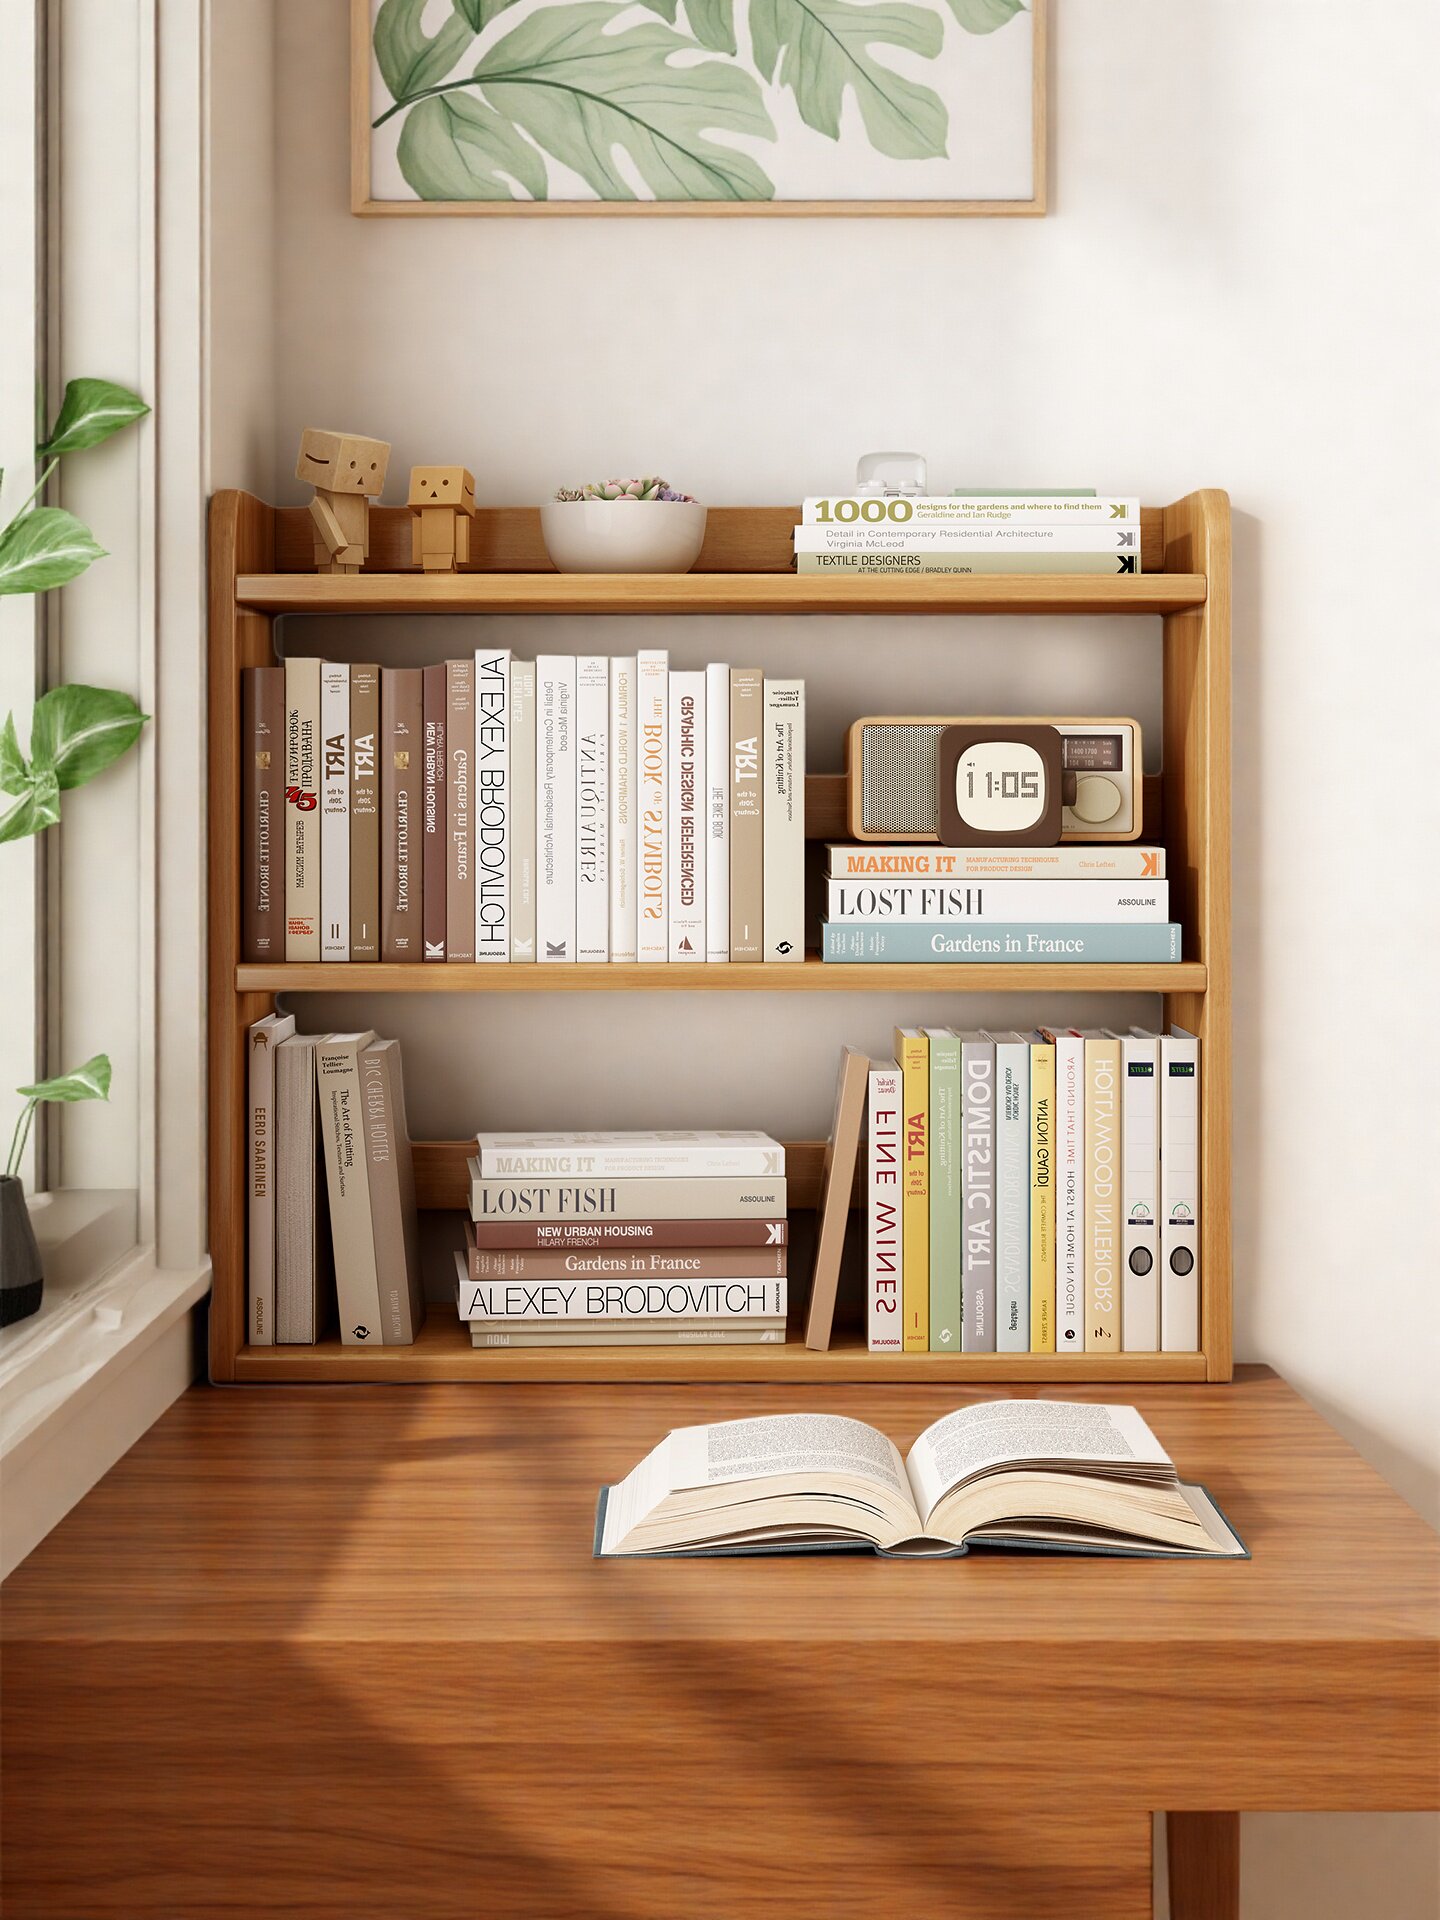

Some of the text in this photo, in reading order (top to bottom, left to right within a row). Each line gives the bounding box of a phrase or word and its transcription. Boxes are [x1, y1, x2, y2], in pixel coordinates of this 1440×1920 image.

[815, 500, 913, 523] 1000
[916, 503, 947, 512] designs
[962, 504, 975, 513] the
[977, 504, 1009, 513] gardens
[986, 511, 1012, 519] Rudge
[826, 530, 854, 538] Detail
[868, 530, 936, 539] Contemporary
[827, 540, 863, 549] Virginia
[816, 555, 921, 568] TEXTILE DESIGNERS
[289, 709, 299, 783] ТАТУИРОВОК
[301, 720, 313, 787] ПРОДАВАНА
[967, 771, 1038, 798] 11:05
[296, 856, 304, 888] МАКСИМ
[847, 855, 957, 873] MAKING IT
[840, 889, 982, 915] LOST FISH
[931, 934, 1084, 952] Gardens in France
[322, 1066, 353, 1074] Loumagne
[340, 1089, 355, 1168] The Art of Knitting
[254, 1108, 266, 1197] EERO SAARINEN
[495, 1155, 595, 1175] MAKING IT
[482, 1188, 615, 1214] LOST FISH
[537, 1226, 653, 1237] NEW URBAN HOUSING
[537, 1238, 599, 1246] HILARY FRENCH
[565, 1255, 701, 1271] Gardens in France
[468, 1284, 765, 1315] ALEXEY BRODOVITCH
